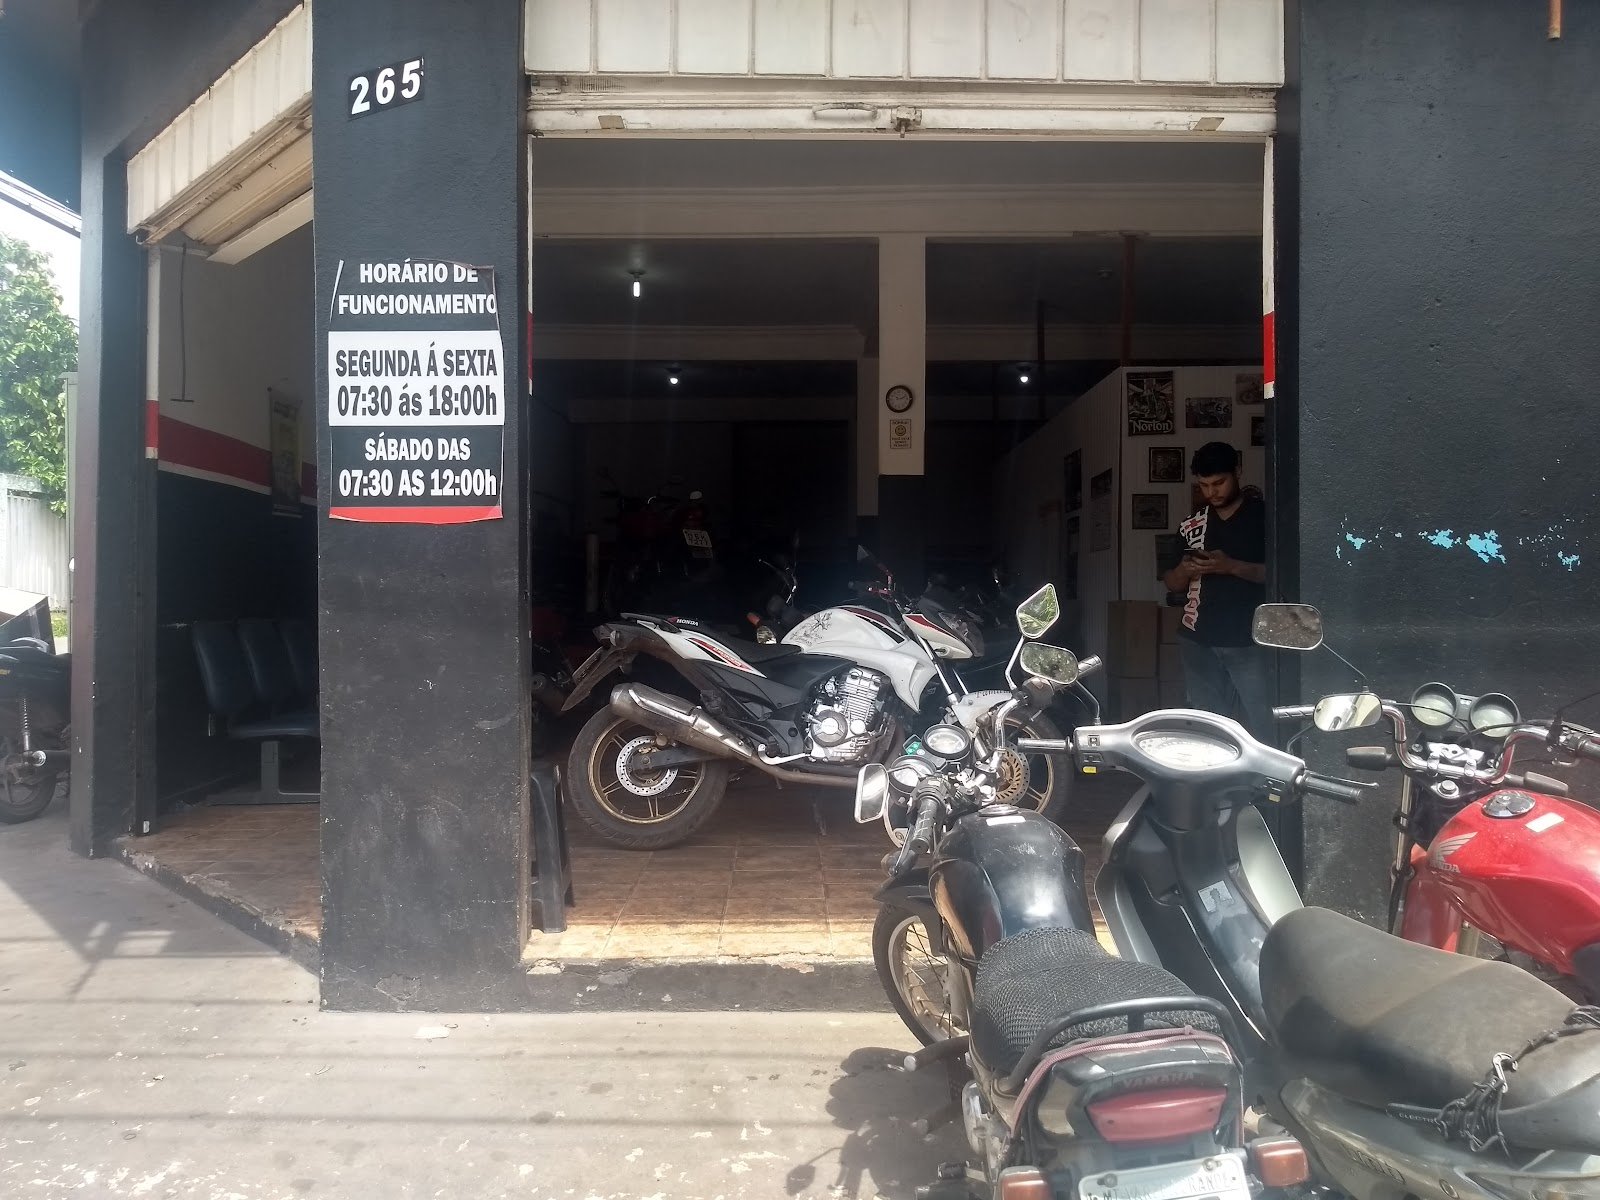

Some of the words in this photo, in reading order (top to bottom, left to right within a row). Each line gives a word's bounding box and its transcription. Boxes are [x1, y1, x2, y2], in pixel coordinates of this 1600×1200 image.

[350, 60, 420, 115] 265
[360, 257, 448, 283] HORÁRIO
[453, 264, 479, 283] DE
[338, 294, 497, 315] FUNCIONAMENTO
[335, 349, 422, 377] SEGUNDA
[426, 341, 439, 377] Á
[443, 349, 498, 377] SEXTA
[337, 385, 393, 417] 07:30
[398, 383, 423, 417] ás
[429, 384, 497, 416] 18:00h
[1129, 419, 1174, 433] Norton
[364, 432, 434, 461] SÁBADO
[437, 437, 471, 461] DAS
[338, 469, 393, 497] 07:30
[398, 469, 425, 497] AS
[430, 468, 497, 496] 12:00h
[676, 618, 699, 627] HONDA
